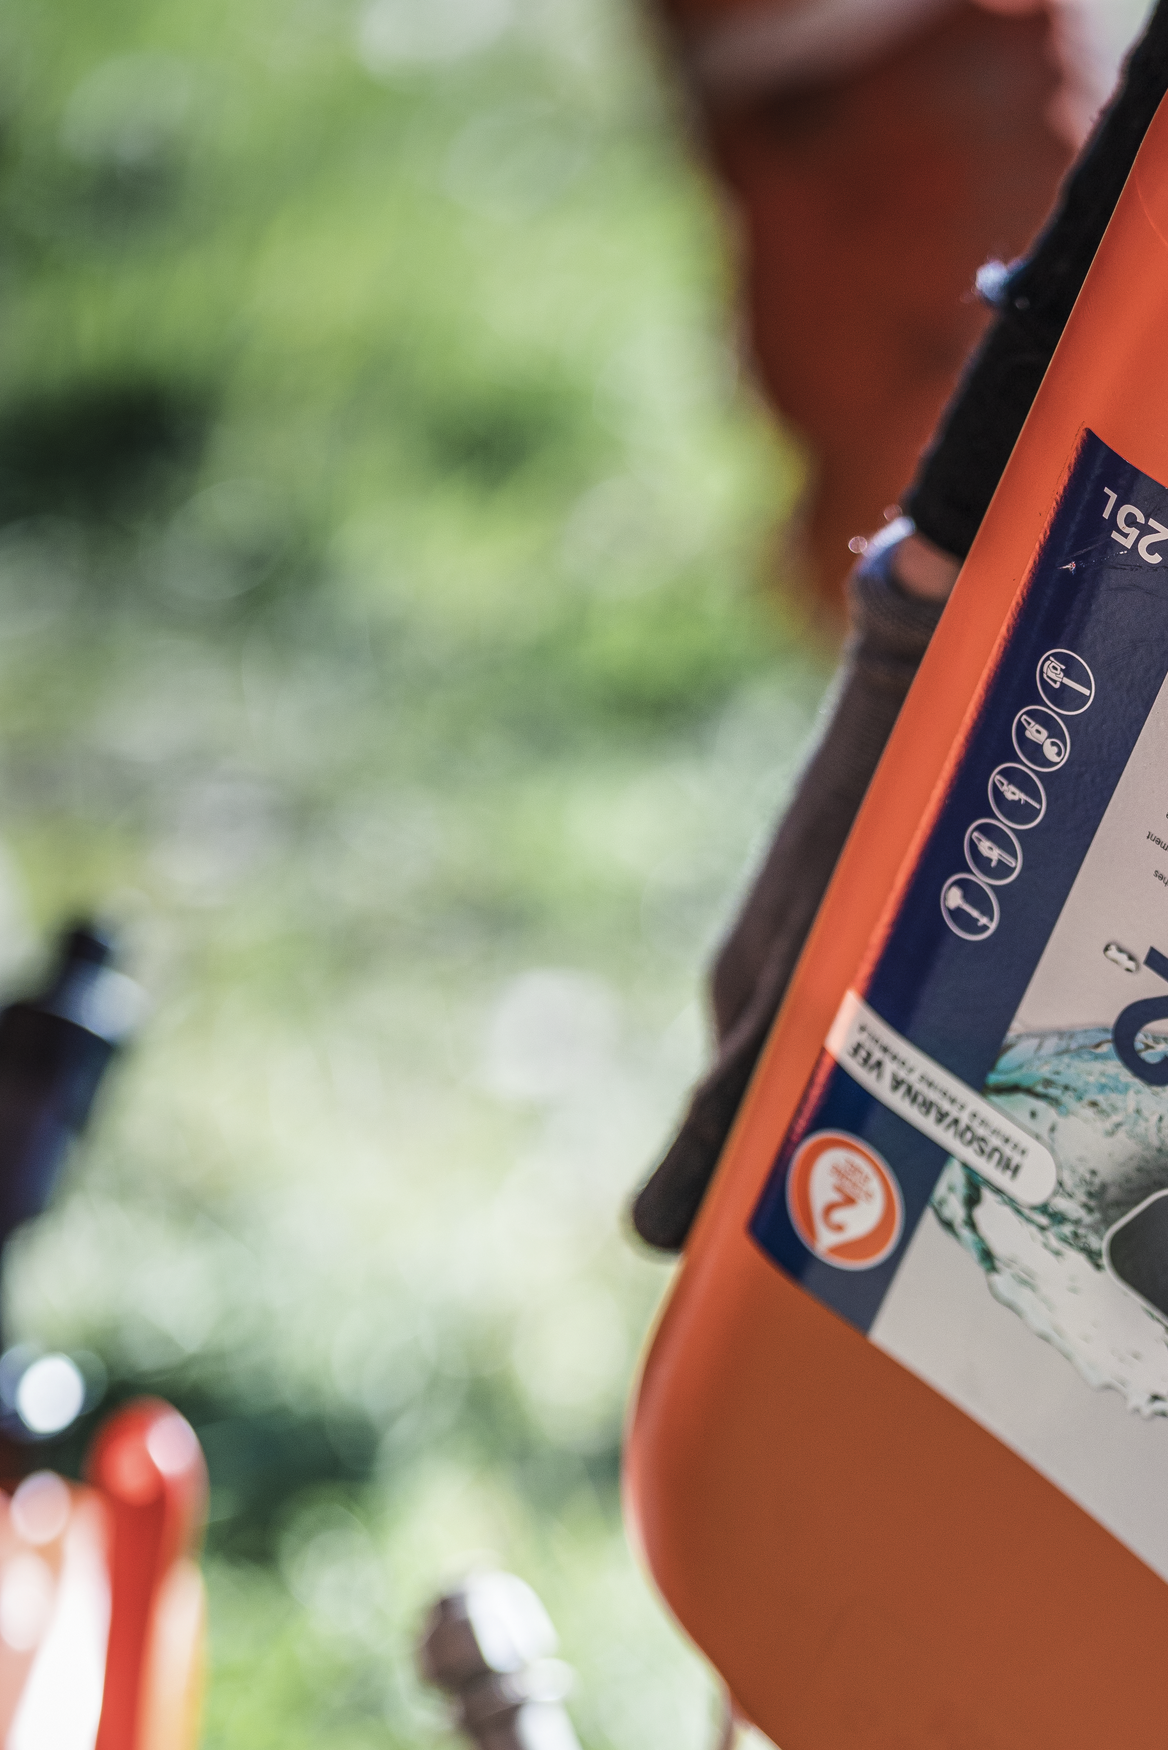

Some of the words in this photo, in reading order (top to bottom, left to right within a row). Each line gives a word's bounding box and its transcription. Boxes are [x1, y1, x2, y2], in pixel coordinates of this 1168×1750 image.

[846, 1041, 880, 1079] VEF
[888, 1072, 1021, 1180] HUSQVARNA
[821, 1184, 857, 1232] 2
